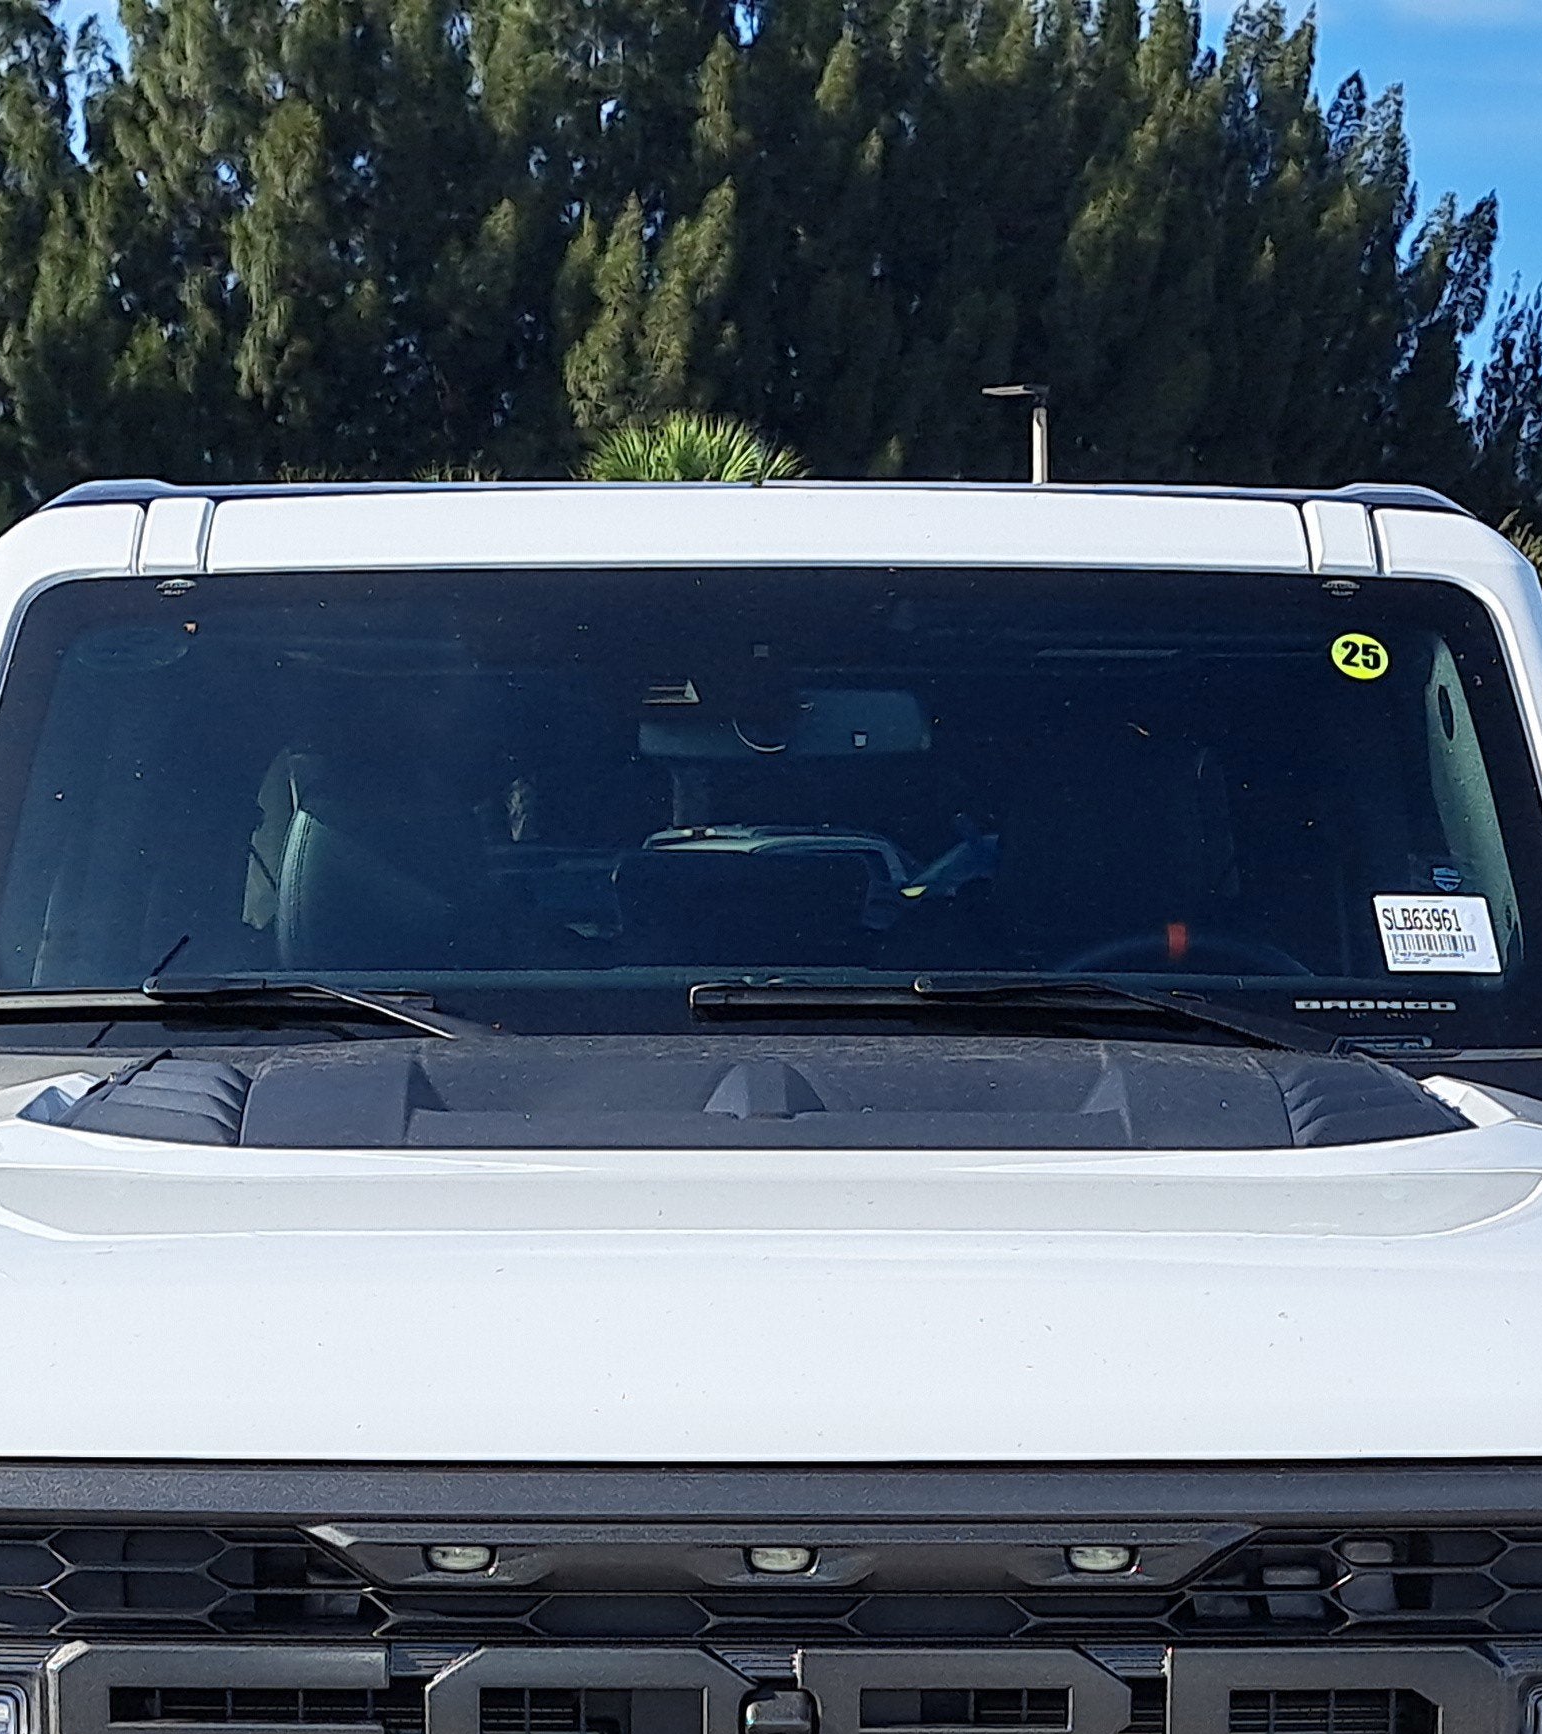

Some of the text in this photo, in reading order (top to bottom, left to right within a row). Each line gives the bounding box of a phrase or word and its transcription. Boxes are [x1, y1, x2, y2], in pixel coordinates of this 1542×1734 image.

[1341, 640, 1381, 670] 25
[1382, 907, 1462, 932] SLB63961
[1295, 1000, 1456, 1010] BRONCO
